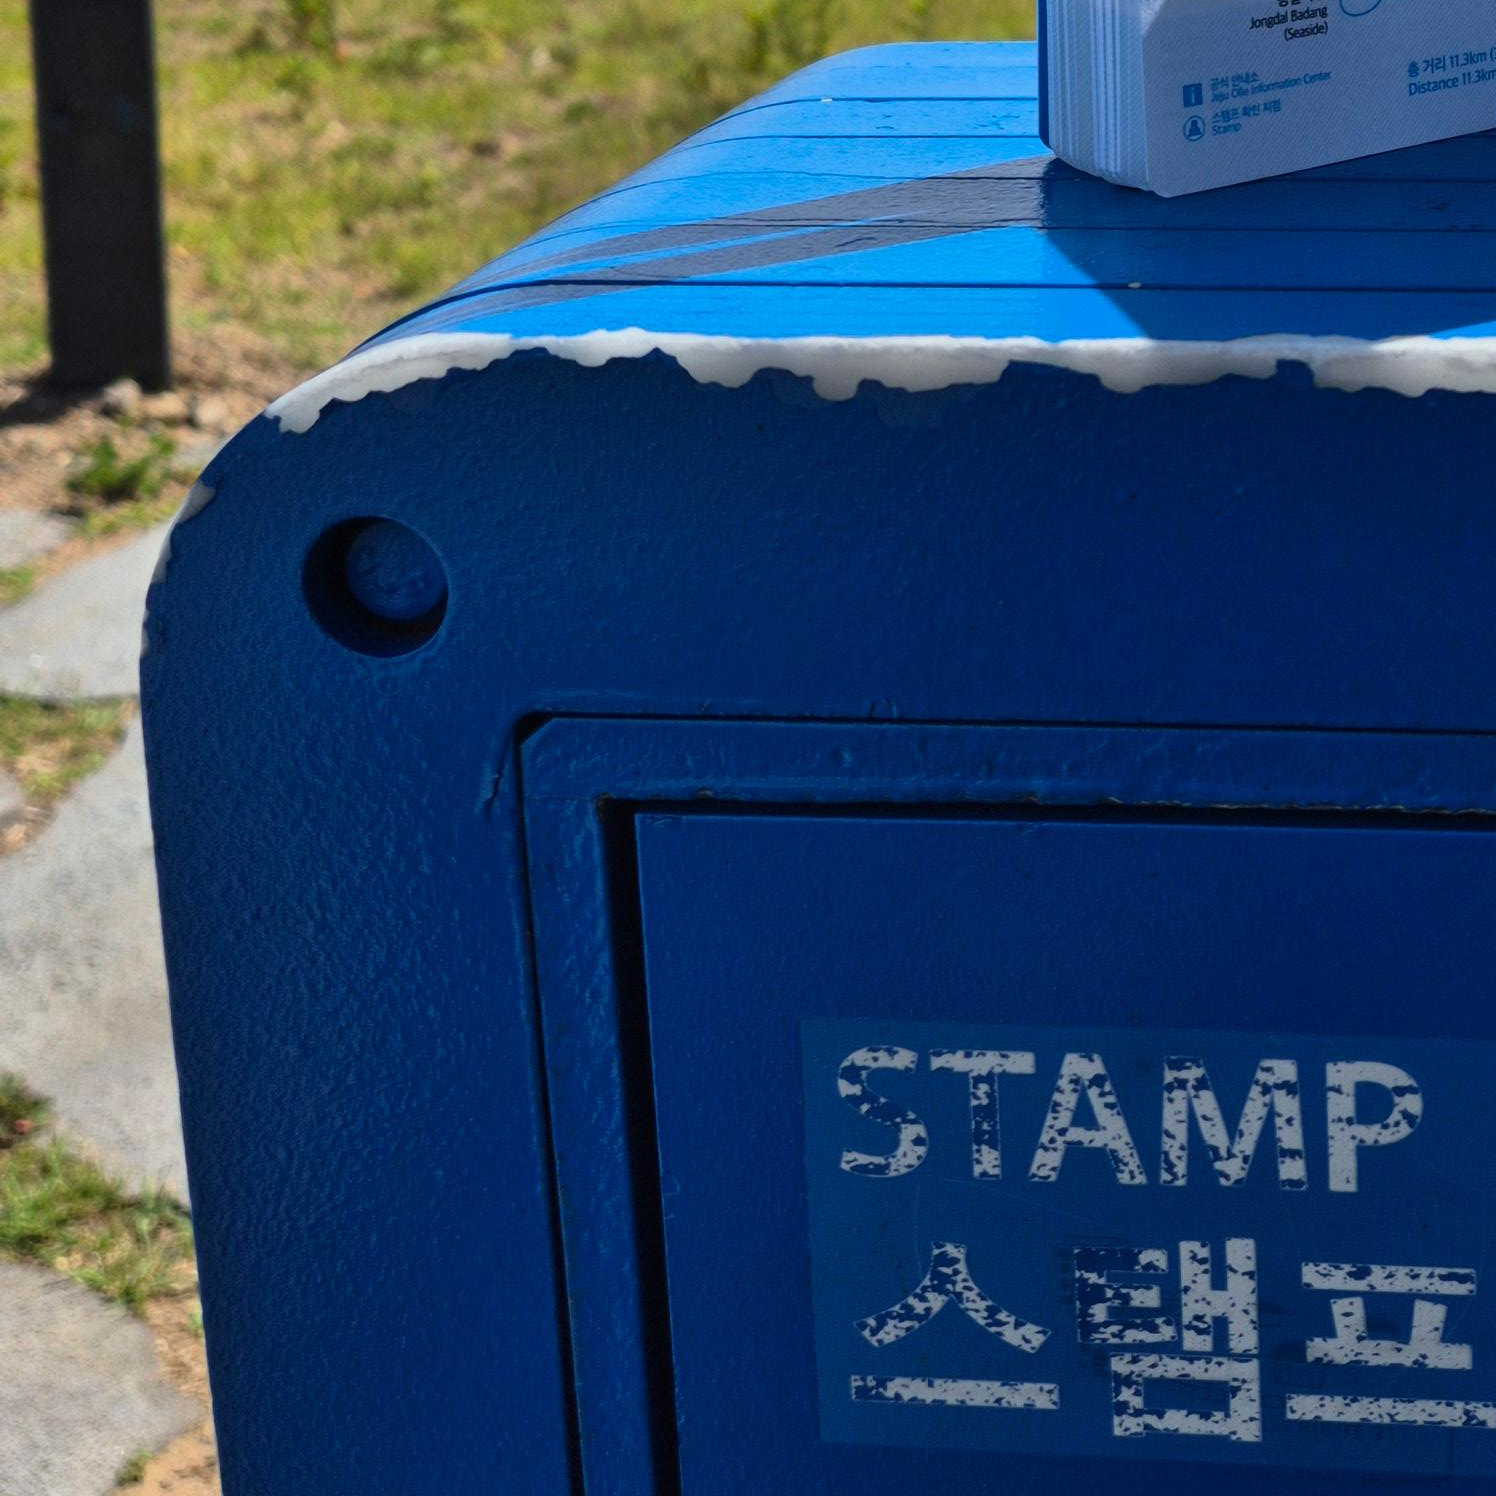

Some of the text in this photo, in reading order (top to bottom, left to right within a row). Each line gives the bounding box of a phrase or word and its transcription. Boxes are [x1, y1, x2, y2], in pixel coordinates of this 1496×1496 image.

[1249, 5, 1328, 31] Jongdal Badang
[1284, 22, 1329, 42] (Seaside)
[1408, 60, 1420, 78] 총
[1423, 56, 1446, 74] 거리
[1449, 50, 1487, 68] 11.3km
[1251, 69, 1331, 97] Information Center
[1408, 78, 1459, 96] Distance
[1212, 121, 1241, 136] Stamp
[837, 1045, 1424, 1193] STAMP
